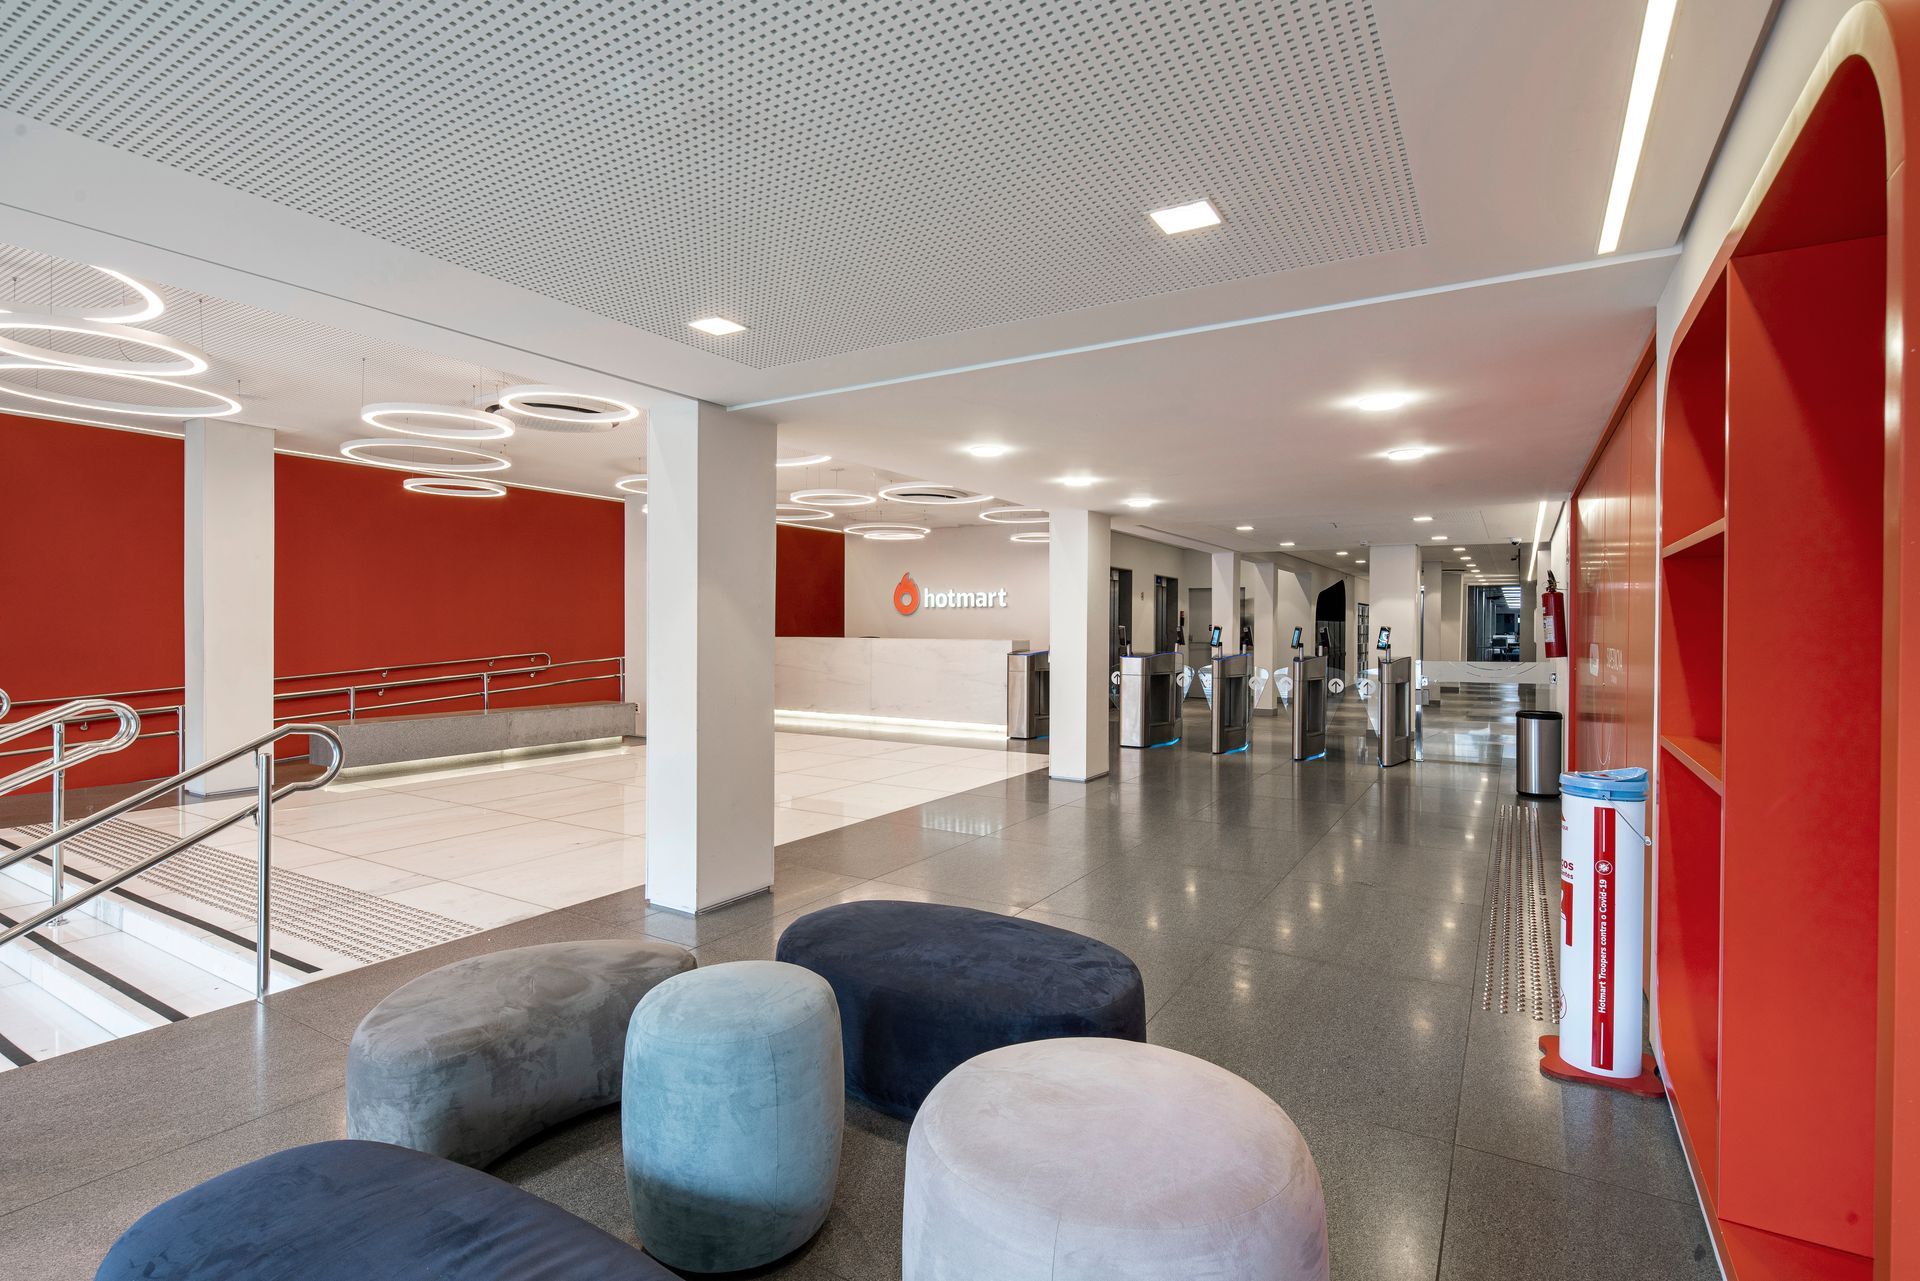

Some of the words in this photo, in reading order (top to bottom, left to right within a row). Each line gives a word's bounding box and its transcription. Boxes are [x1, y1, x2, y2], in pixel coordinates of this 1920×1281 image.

[924, 588, 1007, 608] hotmart
[1599, 947, 1607, 979] Troopers
[1598, 981, 1606, 1013] Hotmart
